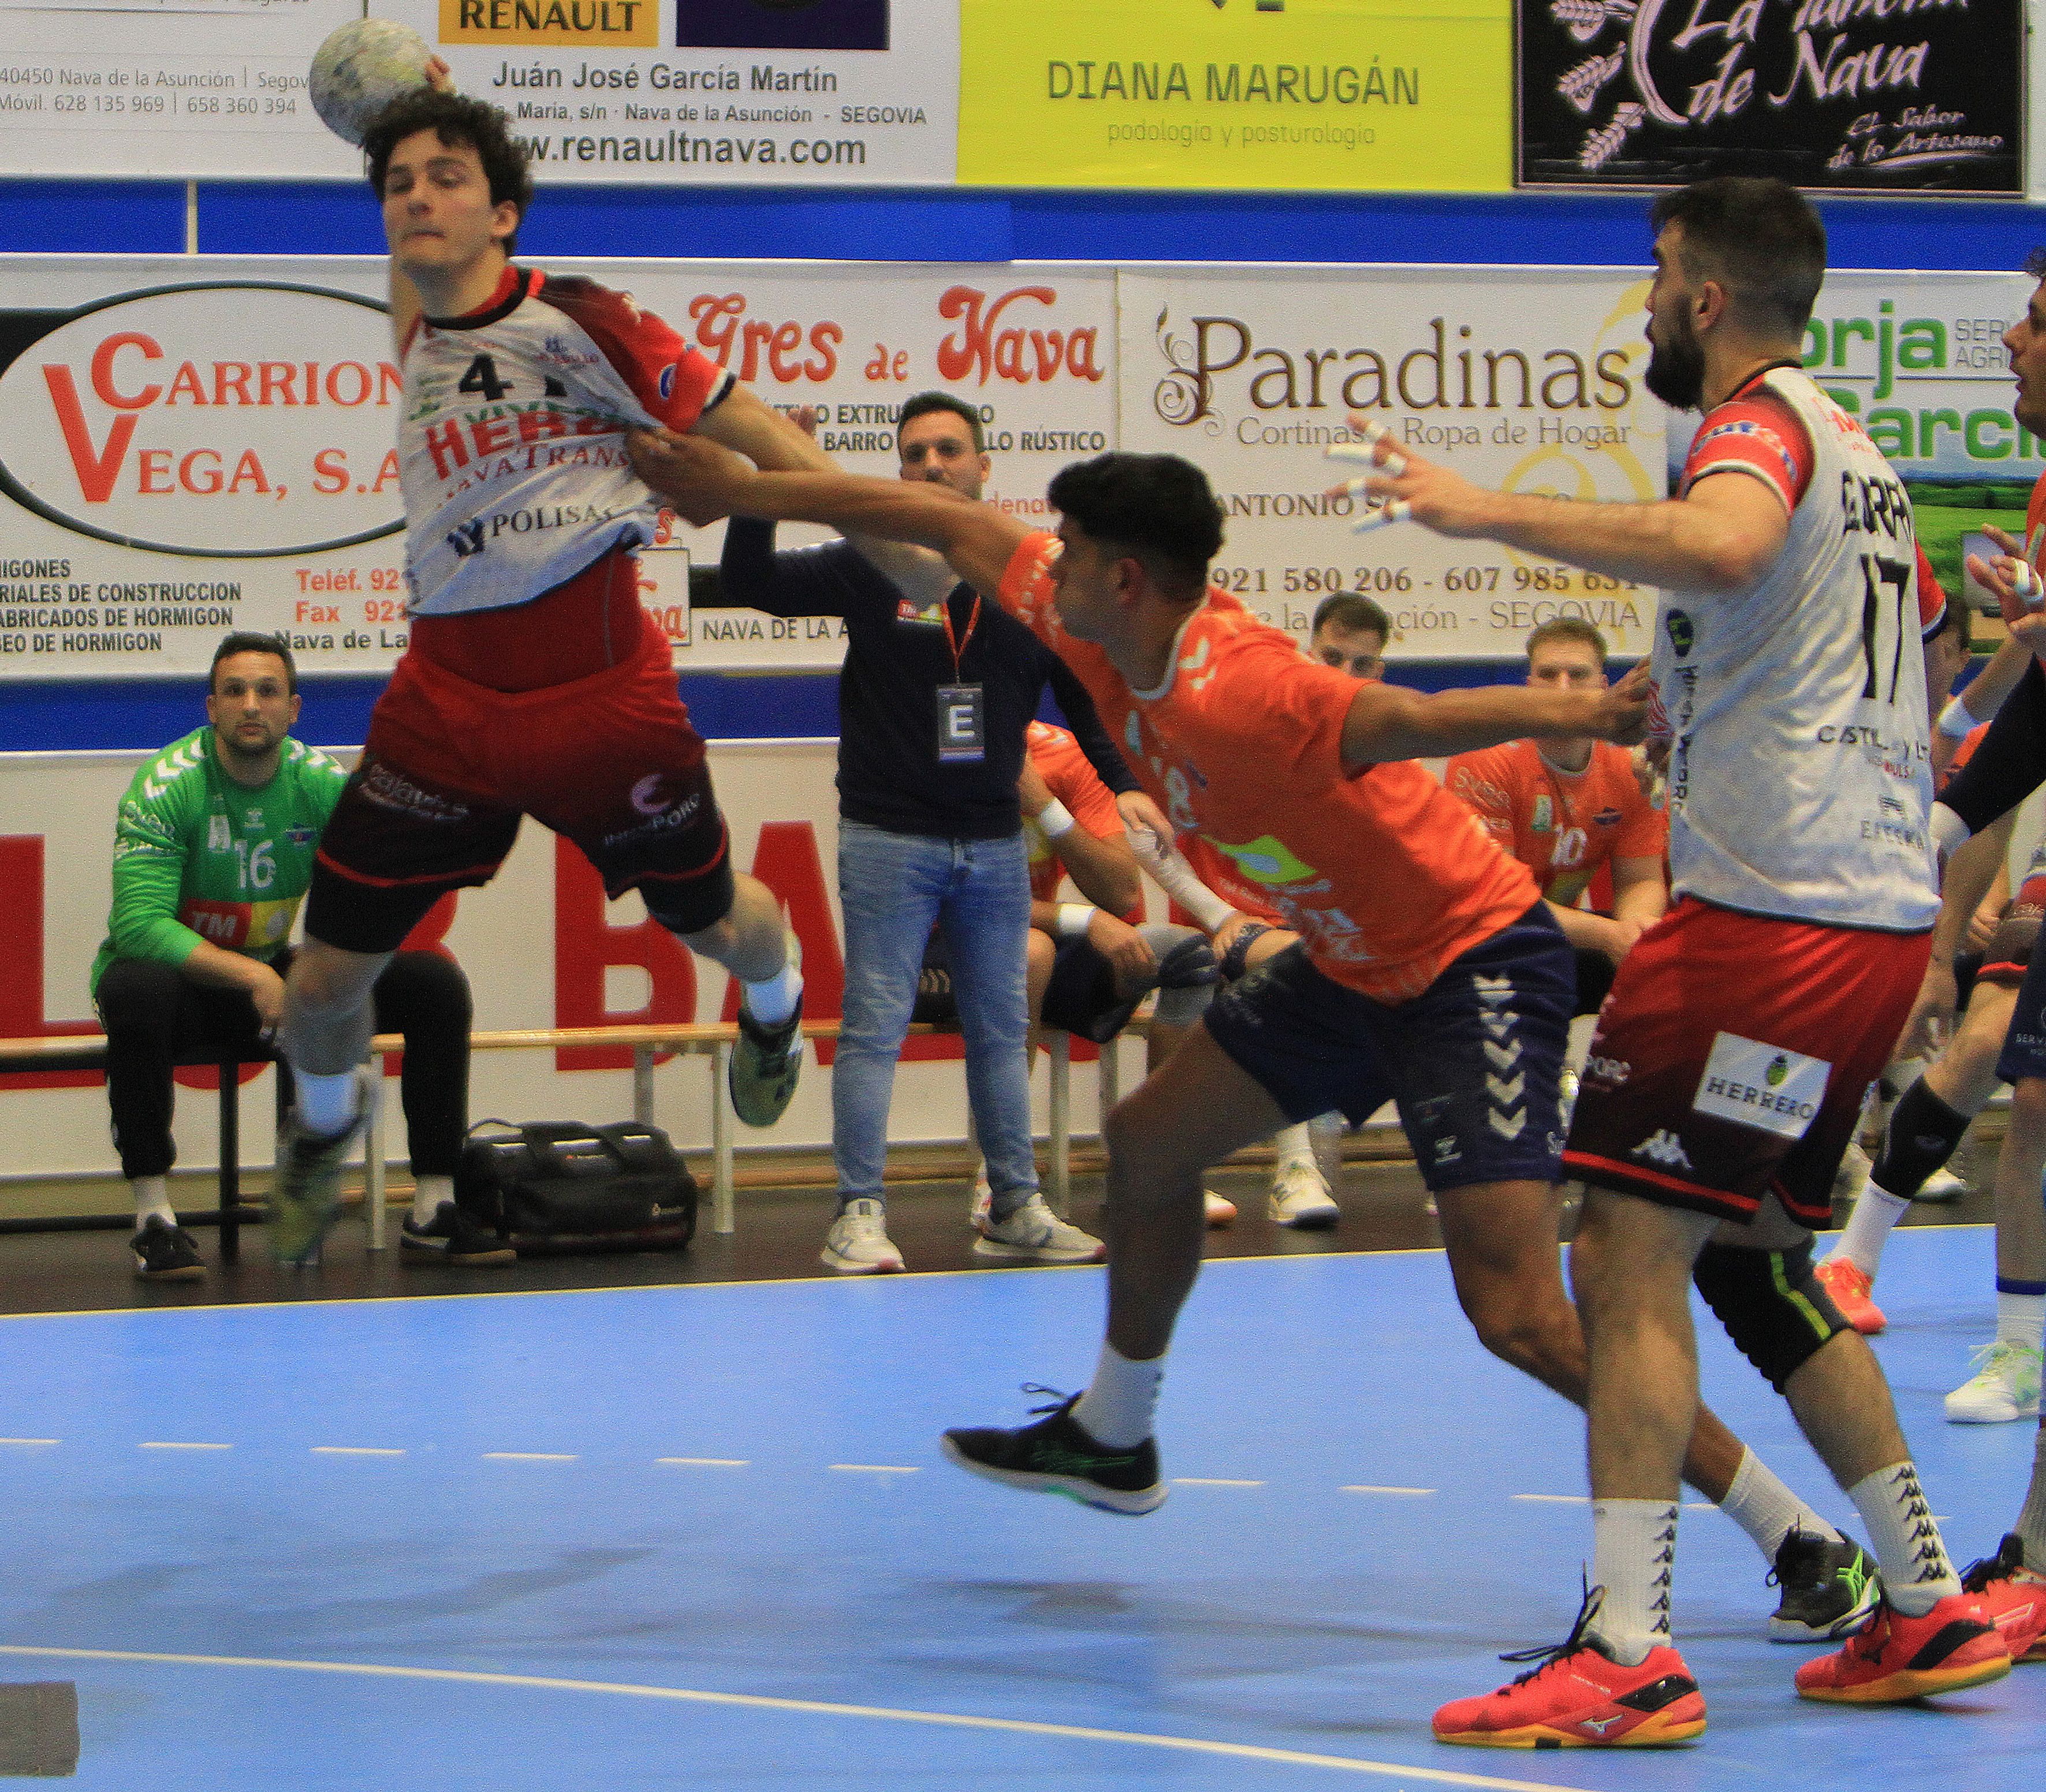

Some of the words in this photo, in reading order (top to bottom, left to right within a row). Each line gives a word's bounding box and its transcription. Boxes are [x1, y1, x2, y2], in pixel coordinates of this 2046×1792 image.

[459, 0, 642, 32] RENAULT
[0, 67, 53, 84] 40450
[60, 69, 102, 85] Nava
[109, 69, 129, 85] de
[135, 69, 150, 85] la
[156, 70, 235, 87] Asunción
[493, 60, 562, 87] Juán
[572, 61, 639, 89] José
[650, 62, 740, 90] García
[751, 65, 837, 91] Martín
[1048, 61, 1191, 101] DIANA
[1206, 55, 1419, 105] MARUGÁN
[1688, 42, 1756, 125] de
[1767, 29, 1929, 108] Nava
[55, 95, 86, 111] 628
[95, 95, 125, 111] 135
[132, 96, 164, 112] 969
[188, 96, 219, 113] 658
[226, 97, 258, 113] 360
[265, 98, 297, 114] 394
[580, 103, 607, 120] s/n
[625, 103, 670, 120] Nava
[677, 103, 698, 120] de
[705, 104, 720, 121] la
[725, 104, 812, 122] Asunción
[841, 105, 926, 124] SEGOVIA
[1892, 104, 1965, 130] Sabor
[1220, 126, 1231, 148] y
[1890, 132, 2004, 155] Artesano
[690, 293, 843, 383] Gres
[937, 285, 1105, 387] Nava
[1191, 316, 1634, 419] Paradinas
[823, 431, 893, 451] BARRO
[1020, 423, 1106, 453] RÚSTICO
[1237, 416, 1365, 446] Cortinas
[1404, 417, 1482, 452] Ropa
[1493, 419, 1527, 446] de
[1537, 417, 1633, 452] Hogar
[0, 558, 70, 577] IGONES
[296, 568, 363, 592] Teléf.
[370, 568, 409, 592] 92
[1213, 566, 1268, 592] 921
[1284, 567, 1343, 593] 580
[1354, 566, 1413, 592] 206
[1445, 567, 1501, 592] 607
[1514, 566, 1570, 592] 985
[68, 583, 91, 602] DE
[97, 582, 241, 602] CONSTRUCCION
[105, 608, 128, 626] DE
[135, 607, 233, 626] HORMIGON
[296, 600, 340, 624] Fax
[1283, 603, 1308, 630] la
[1490, 600, 1641, 629] SEGOVIA
[275, 628, 334, 649] Nava
[343, 629, 371, 649] de
[380, 628, 408, 648] La
[703, 618, 764, 640] NAVA
[771, 618, 798, 639] DE
[805, 617, 830, 639] LA
[1859, 550, 1911, 704] 17
[33, 633, 57, 652] DE
[62, 632, 162, 651] HORMIGON
[949, 703, 975, 741] E
[1551, 824, 1588, 867] 10
[233, 838, 277, 891] 16
[192, 910, 238, 938] TM
